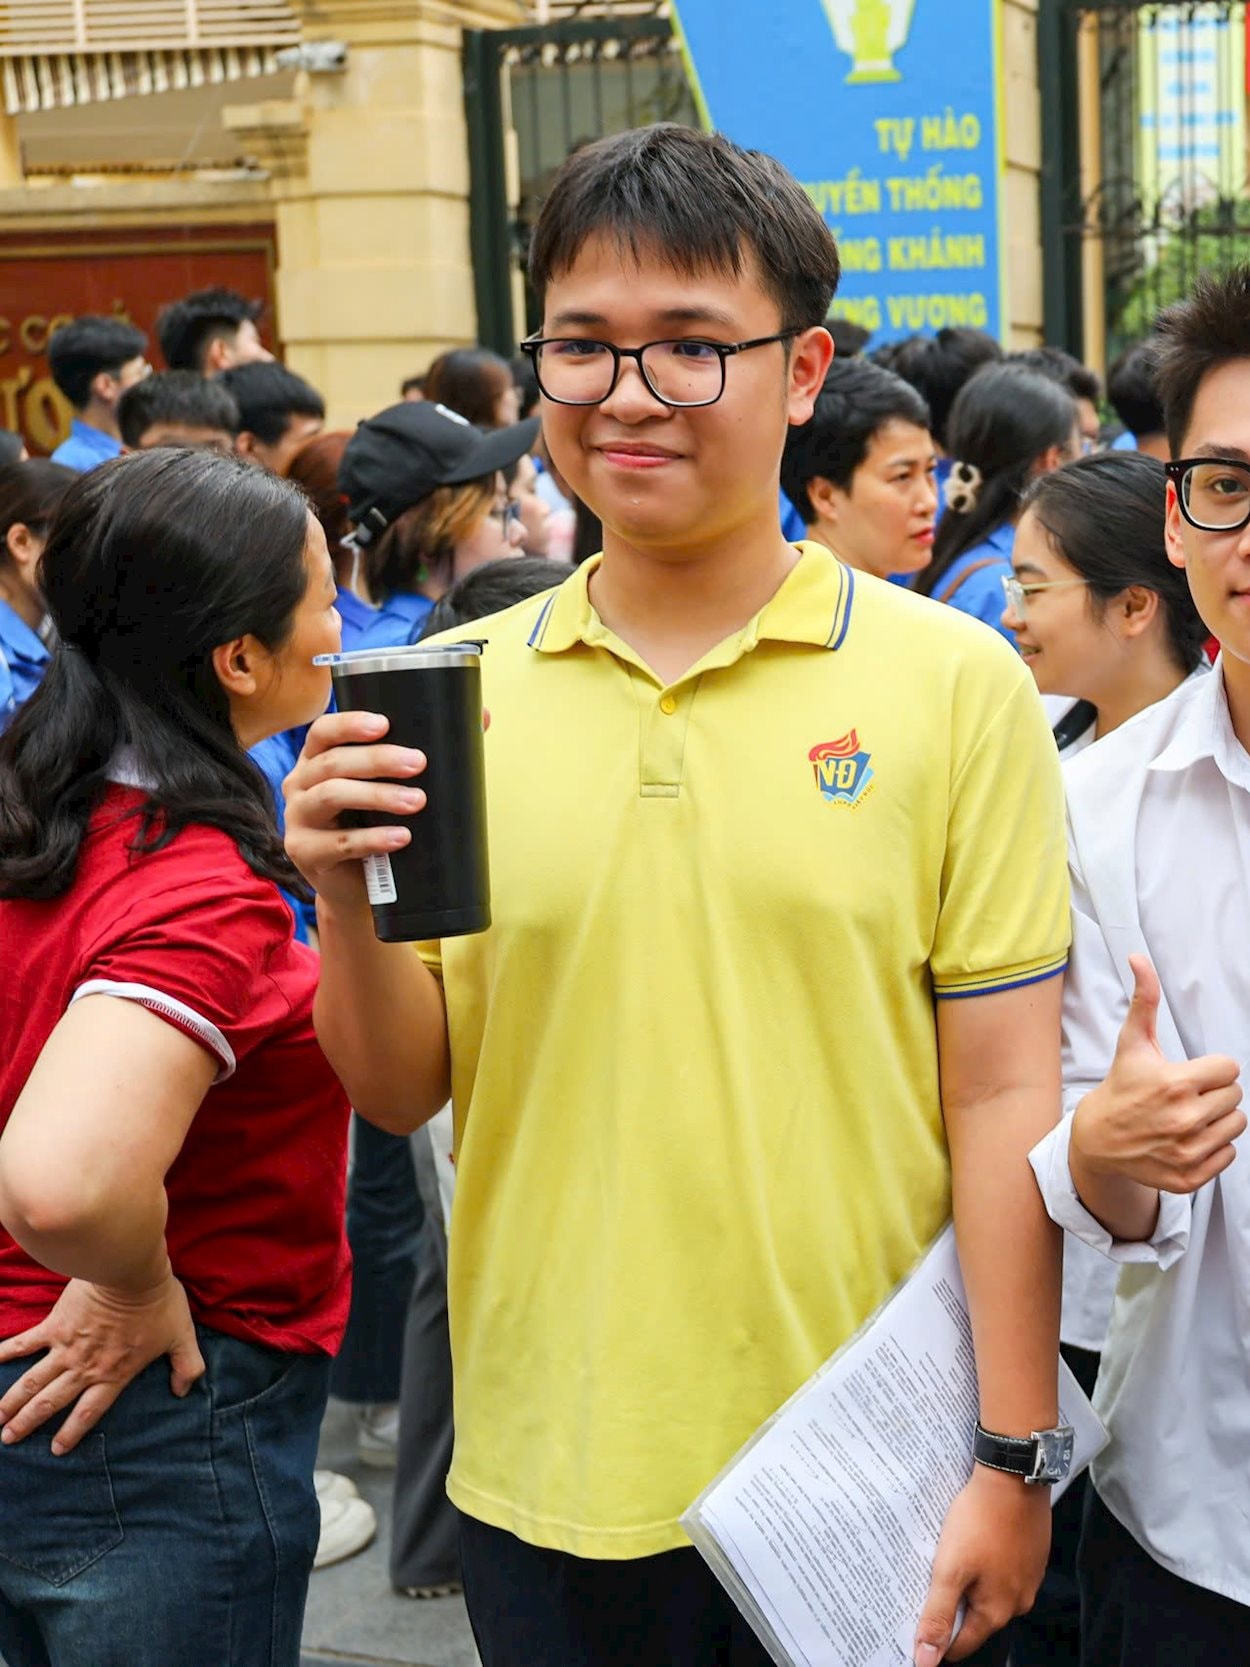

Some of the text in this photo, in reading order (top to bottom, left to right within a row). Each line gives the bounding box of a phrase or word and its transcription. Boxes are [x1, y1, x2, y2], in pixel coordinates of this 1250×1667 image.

[921, 105, 981, 151] HÀO
[886, 163, 984, 212] THỐNG
[887, 226, 986, 271] KHÁNH
